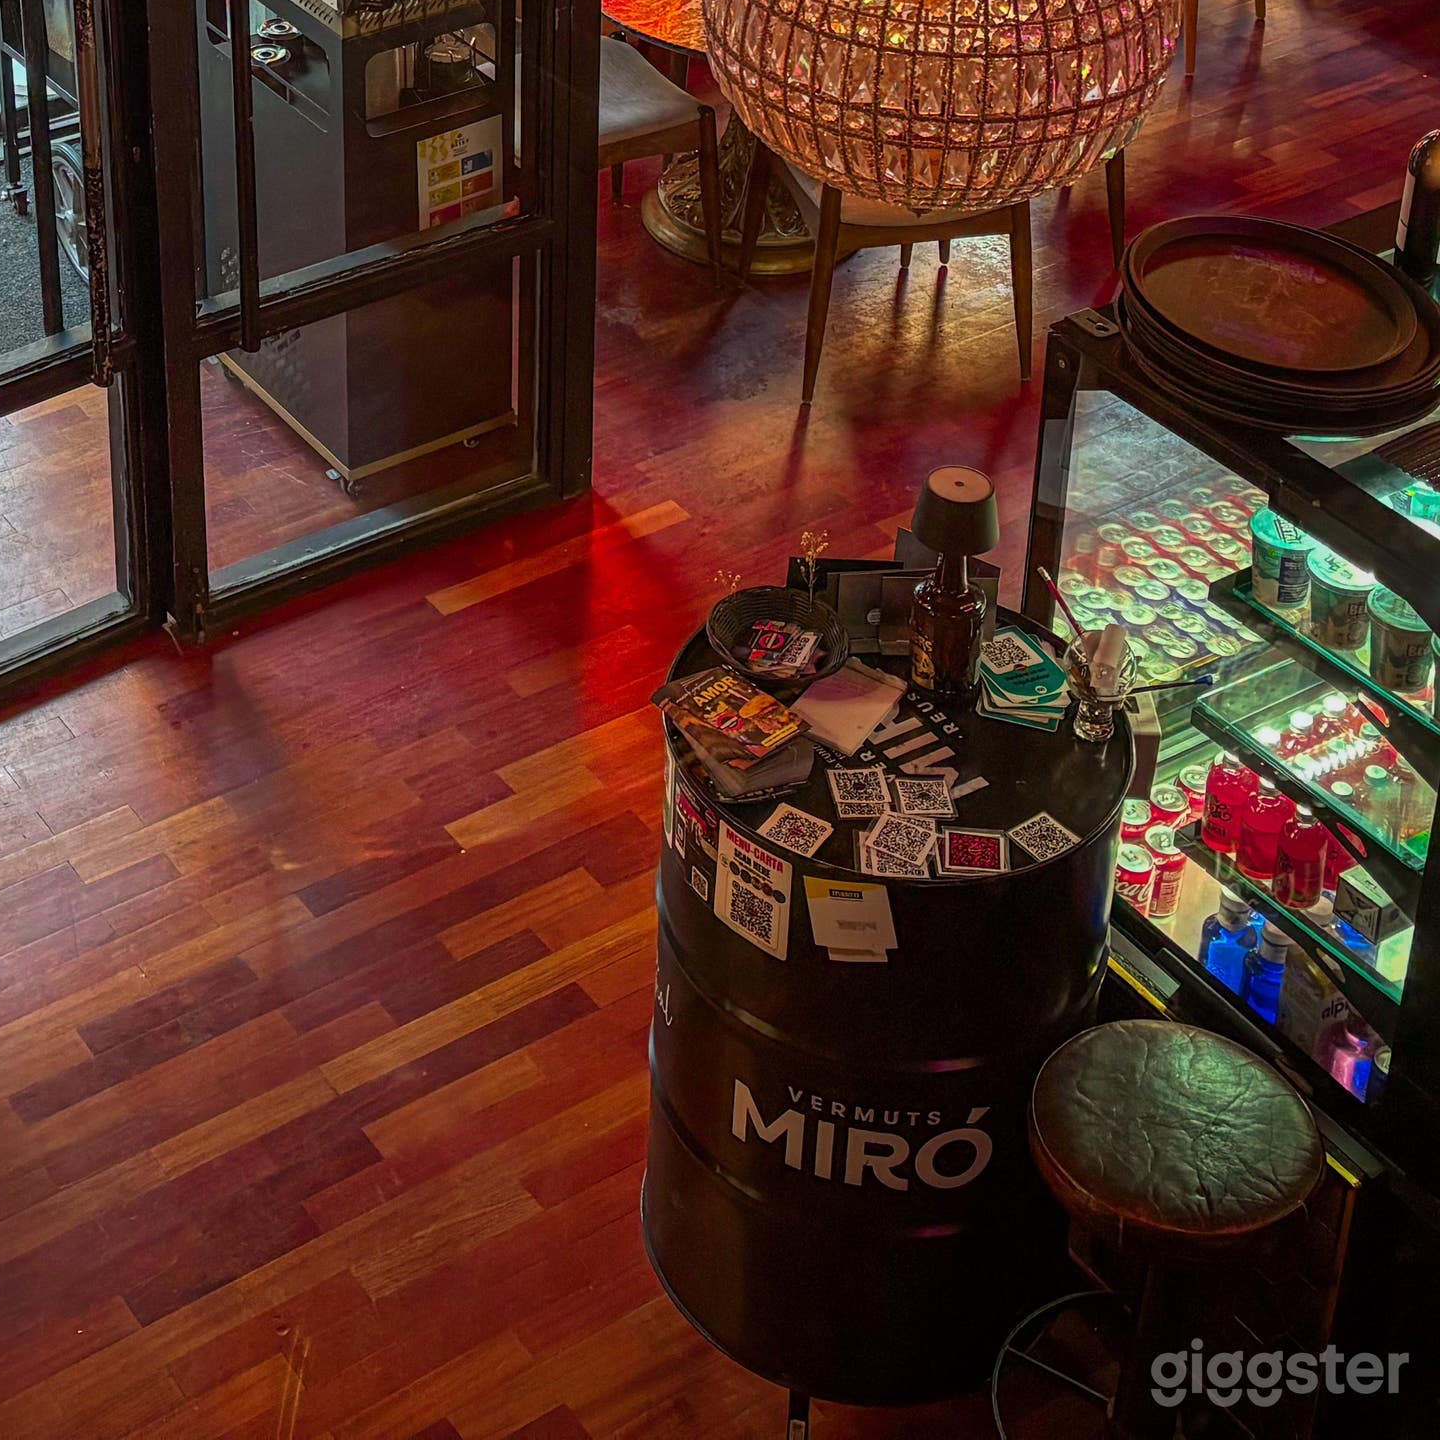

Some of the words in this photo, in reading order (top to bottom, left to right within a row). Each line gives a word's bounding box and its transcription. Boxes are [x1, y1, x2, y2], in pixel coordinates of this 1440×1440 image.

[693, 675, 739, 708] AMOR
[788, 1085, 942, 1127] VERMUTS
[731, 1078, 993, 1191] MIRÓ
